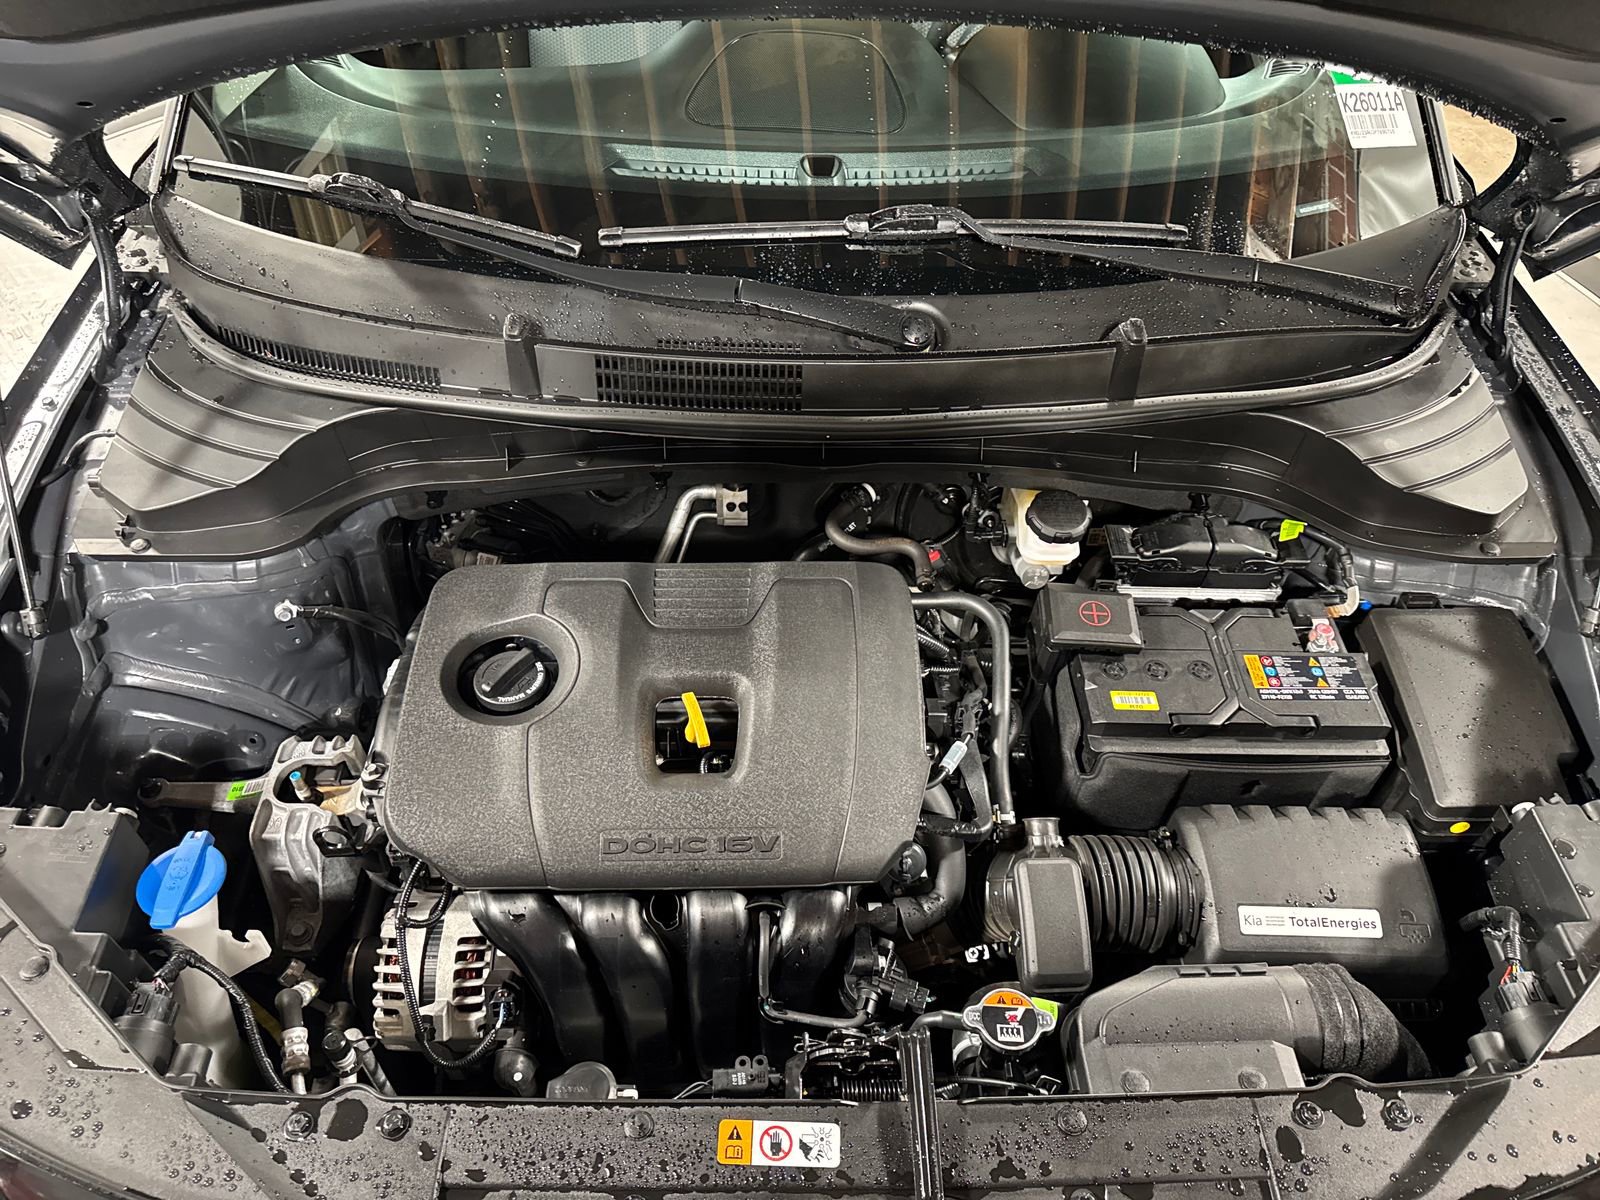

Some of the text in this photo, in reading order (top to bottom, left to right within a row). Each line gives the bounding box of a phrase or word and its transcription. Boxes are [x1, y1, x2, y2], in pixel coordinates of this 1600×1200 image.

[1340, 91, 1404, 113] K26011A
[497, 692, 525, 702] MANUAL
[602, 835, 781, 855] DOHC 16V
[1243, 914, 1377, 931] Kia TotalEnergies
[1038, 1015, 1051, 1025] 1.1
